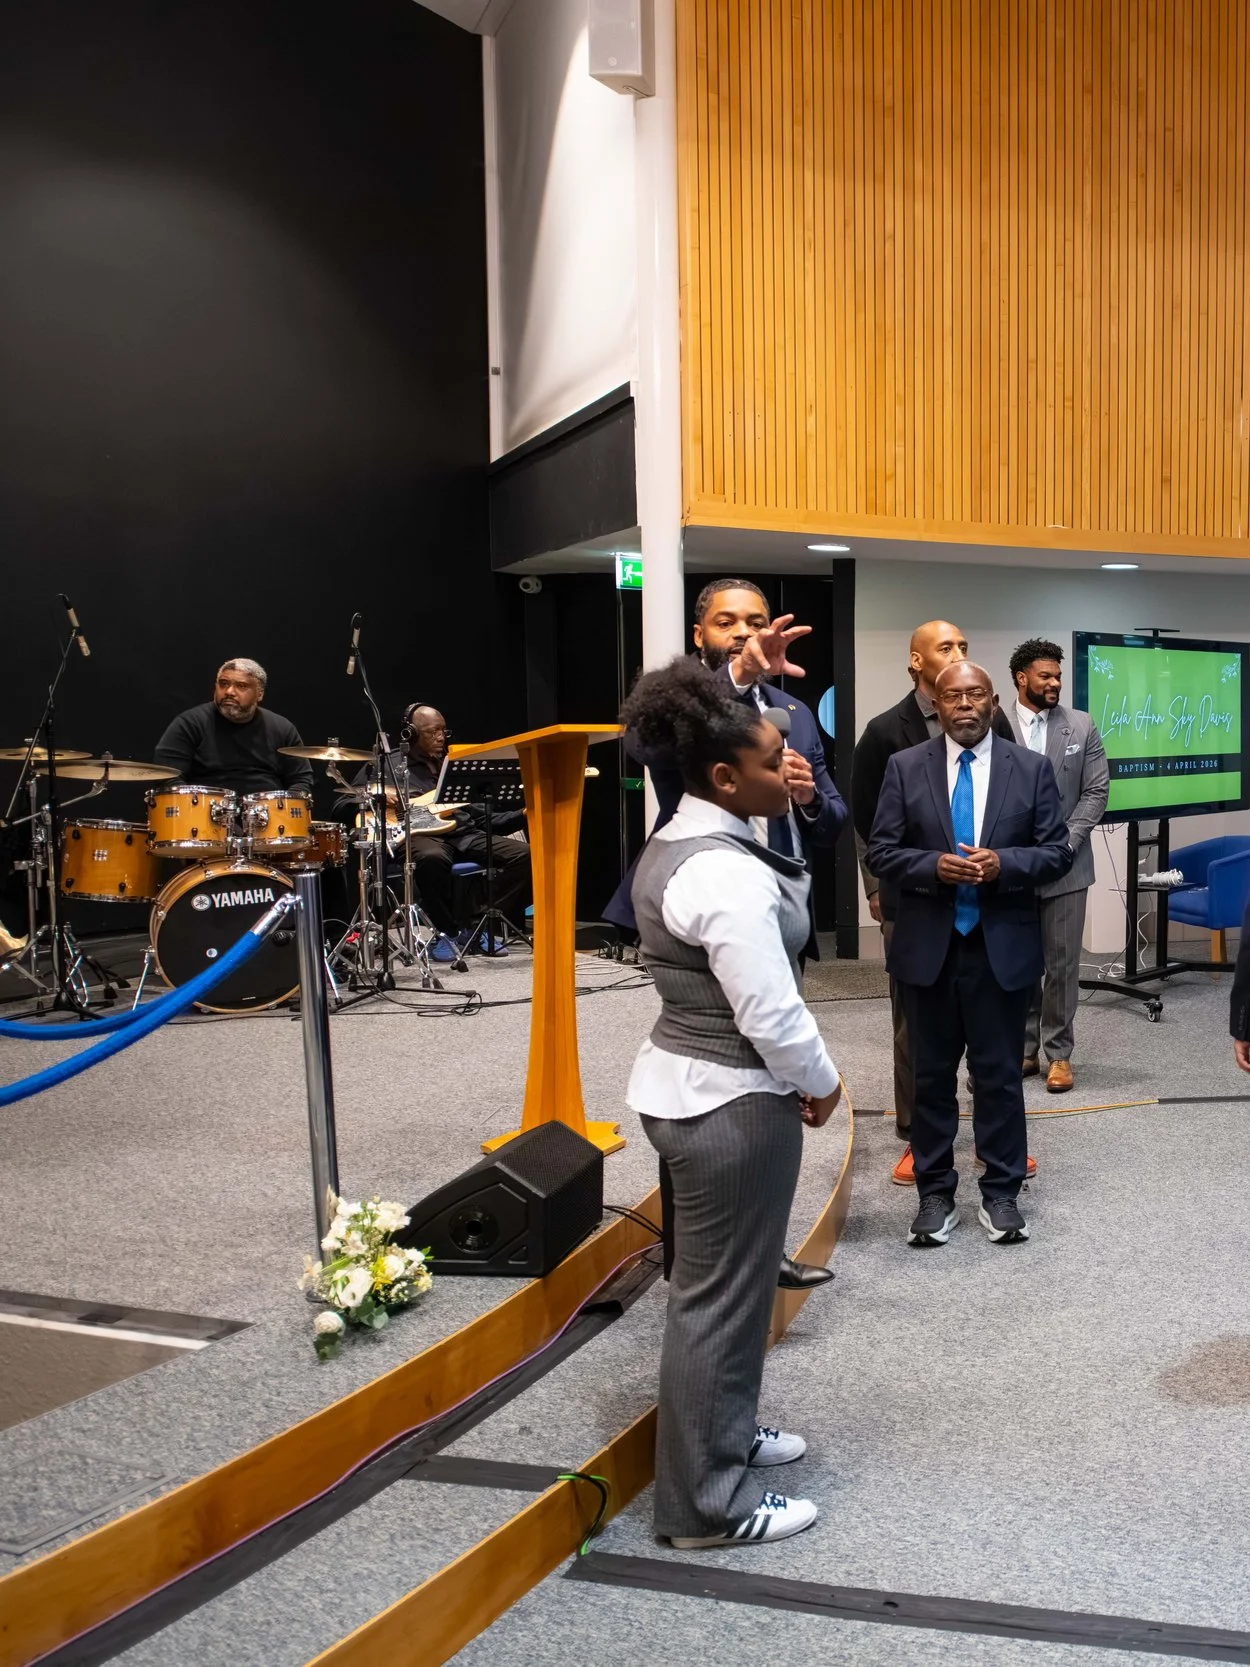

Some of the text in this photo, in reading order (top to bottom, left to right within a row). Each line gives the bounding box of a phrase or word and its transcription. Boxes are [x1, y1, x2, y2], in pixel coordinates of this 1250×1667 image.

[1100, 693, 1233, 747] Leila Ann Sky Davis
[1118, 763, 1155, 773] BAPTISM
[1166, 762, 1171, 770] 4
[1174, 761, 1197, 770] APRIL
[1200, 760, 1218, 768] 2026
[211, 887, 275, 908] YAMAHA
